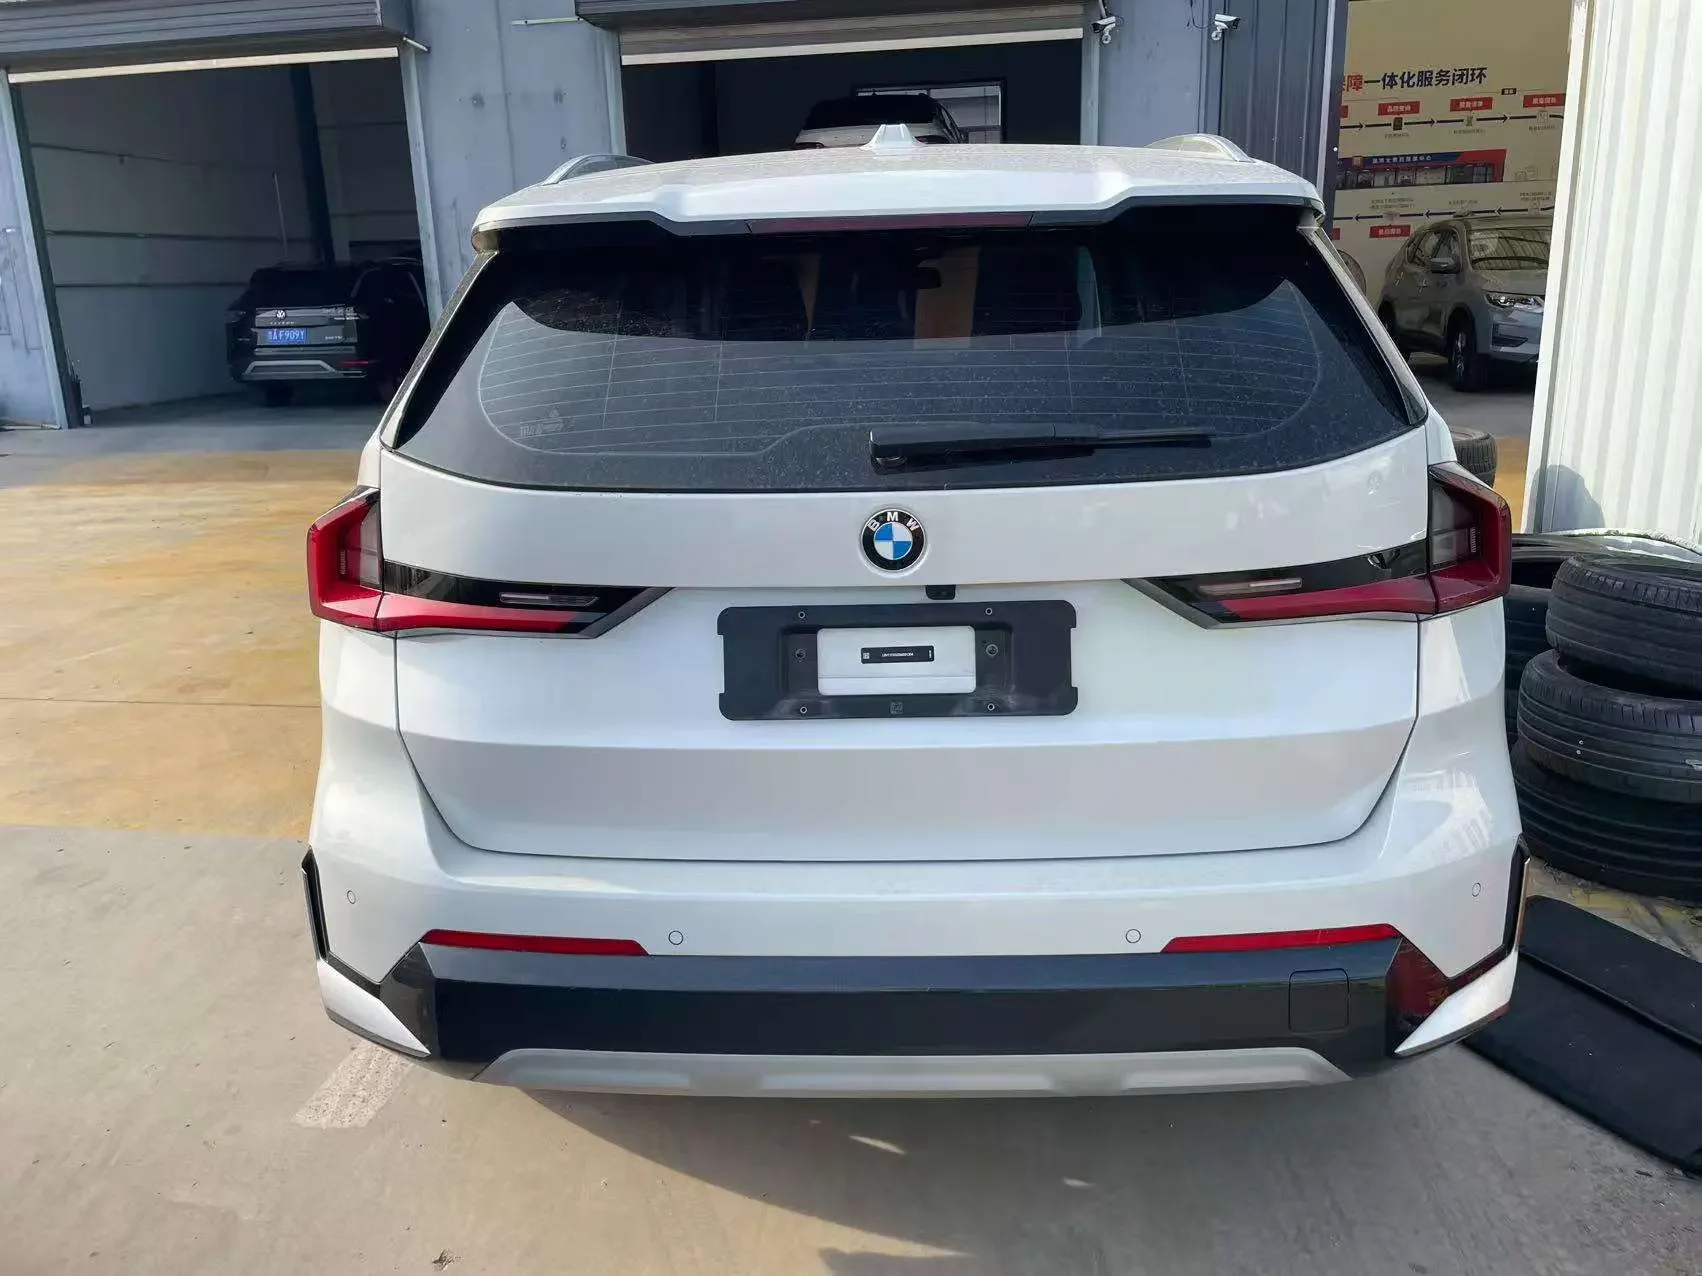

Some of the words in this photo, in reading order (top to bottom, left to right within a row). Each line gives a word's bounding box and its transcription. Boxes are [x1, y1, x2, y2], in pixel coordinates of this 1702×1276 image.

[1343, 67, 1487, 92] 障一体化服务闭环
[867, 512, 919, 531] BMW
